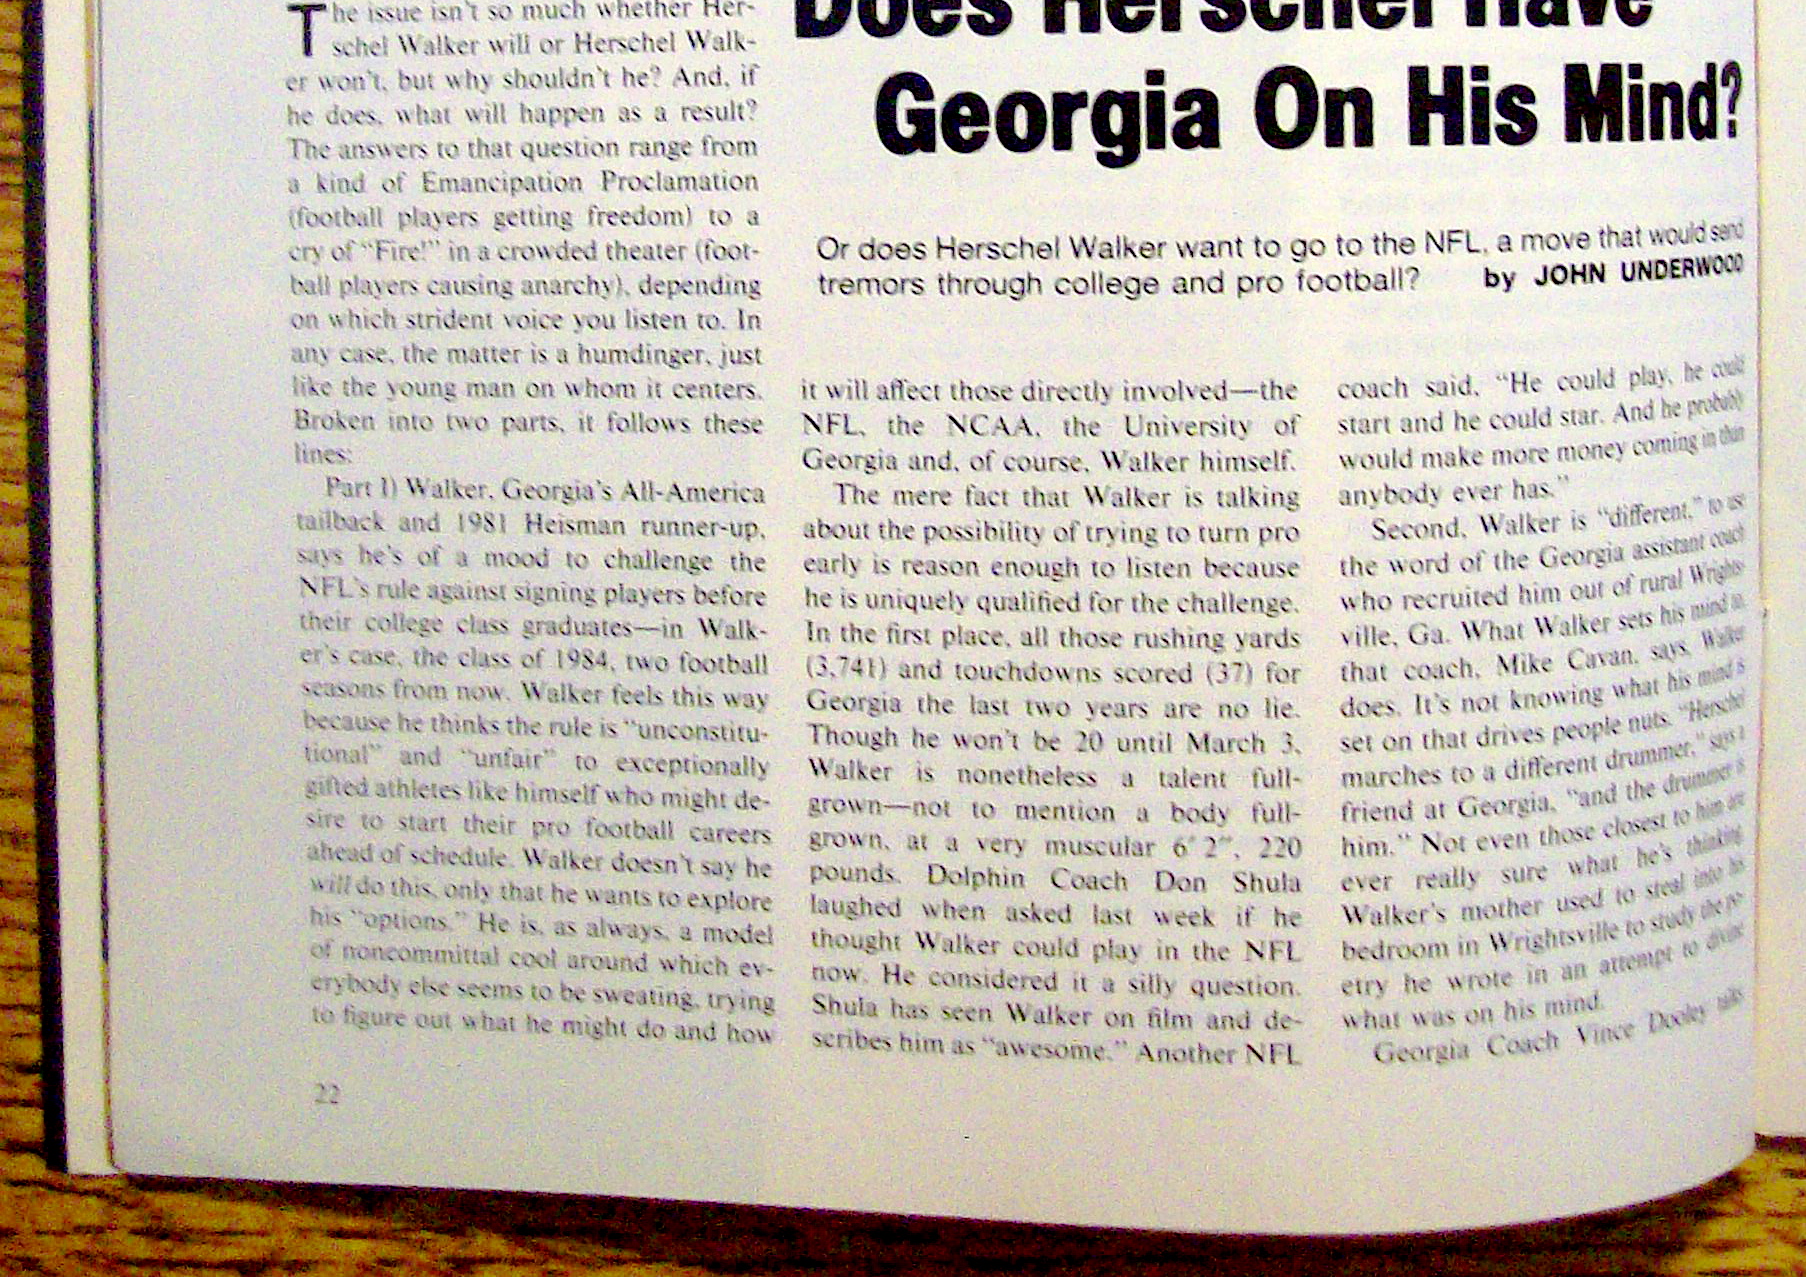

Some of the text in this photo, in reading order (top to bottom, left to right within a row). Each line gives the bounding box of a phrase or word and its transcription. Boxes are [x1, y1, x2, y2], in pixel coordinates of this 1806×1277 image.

[367, 5, 422, 24] issue
[431, 0, 478, 23] isn't
[487, 3, 513, 22] so
[332, 28, 757, 59] schel Walker will or Herschel Walk-
[874, 59, 1743, 170] Georgia On His Mind?
[289, 133, 758, 164] The answers to that question range from
[288, 168, 759, 198] a kind of Emancipation Proclamation
[288, 203, 760, 234] (football players getting freedom) to a
[816, 235, 850, 262] Or
[857, 237, 927, 262] does
[935, 235, 1060, 262] Herschel
[1068, 234, 1168, 261] Walker
[1175, 235, 1244, 260] want
[1253, 235, 1282, 259] to
[1289, 237, 1327, 262] go
[1335, 234, 1364, 258] to
[1371, 230, 1416, 257] the
[1496, 233, 1513, 254] a
[1521, 230, 1591, 252] move
[1598, 224, 1642, 249] that
[1648, 222, 1706, 247] would
[818, 265, 1420, 300] tremors through college and pro football?
[1483, 252, 1744, 294] by JOHN UNDERWOOD
[801, 378, 817, 402] it
[825, 378, 869, 402] will
[876, 377, 941, 403] affect
[949, 378, 1014, 403] those
[1020, 378, 1113, 407] directly
[1338, 446, 1414, 471] would
[1421, 444, 1484, 470] make
[1491, 446, 1550, 467] more
[1556, 441, 1625, 464] money
[1632, 434, 1699, 457] coming
[1338, 480, 1441, 511] anybody
[1453, 483, 1501, 504] ever
[802, 516, 1301, 550] about the possibility of trying to turn pro
[1339, 554, 1378, 579] the
[1387, 551, 1450, 577] word
[1459, 548, 1486, 574] of
[1493, 548, 1530, 573] the
[1538, 541, 1625, 571] Georgia
[1632, 533, 1705, 562] assistant
[807, 756, 1302, 790] Walker is nonetheless a talent full-
[1341, 763, 1442, 790] marches
[1450, 765, 1475, 786] to
[1482, 765, 1497, 784] a
[1504, 754, 1598, 782] different
[304, 774, 771, 815] gifted athletes like himself who might de-
[1340, 900, 1447, 928] Walker's
[1460, 896, 1544, 923] mother
[1556, 886, 1604, 915] used
[1615, 887, 1636, 906] to
[810, 926, 1302, 966] thought Walker could play in the NFL
[311, 1003, 775, 1046] to figure out what he might do and how
[1341, 1007, 1401, 1031] what
[1411, 1009, 1456, 1029] was
[1463, 1006, 1495, 1027] on
[1503, 997, 1536, 1023] his
[811, 1028, 893, 1053] scribes
[899, 1031, 945, 1055] him
[951, 1039, 976, 1057] as
[1136, 1041, 1237, 1066] Another
[1244, 1041, 1302, 1067] NFL
